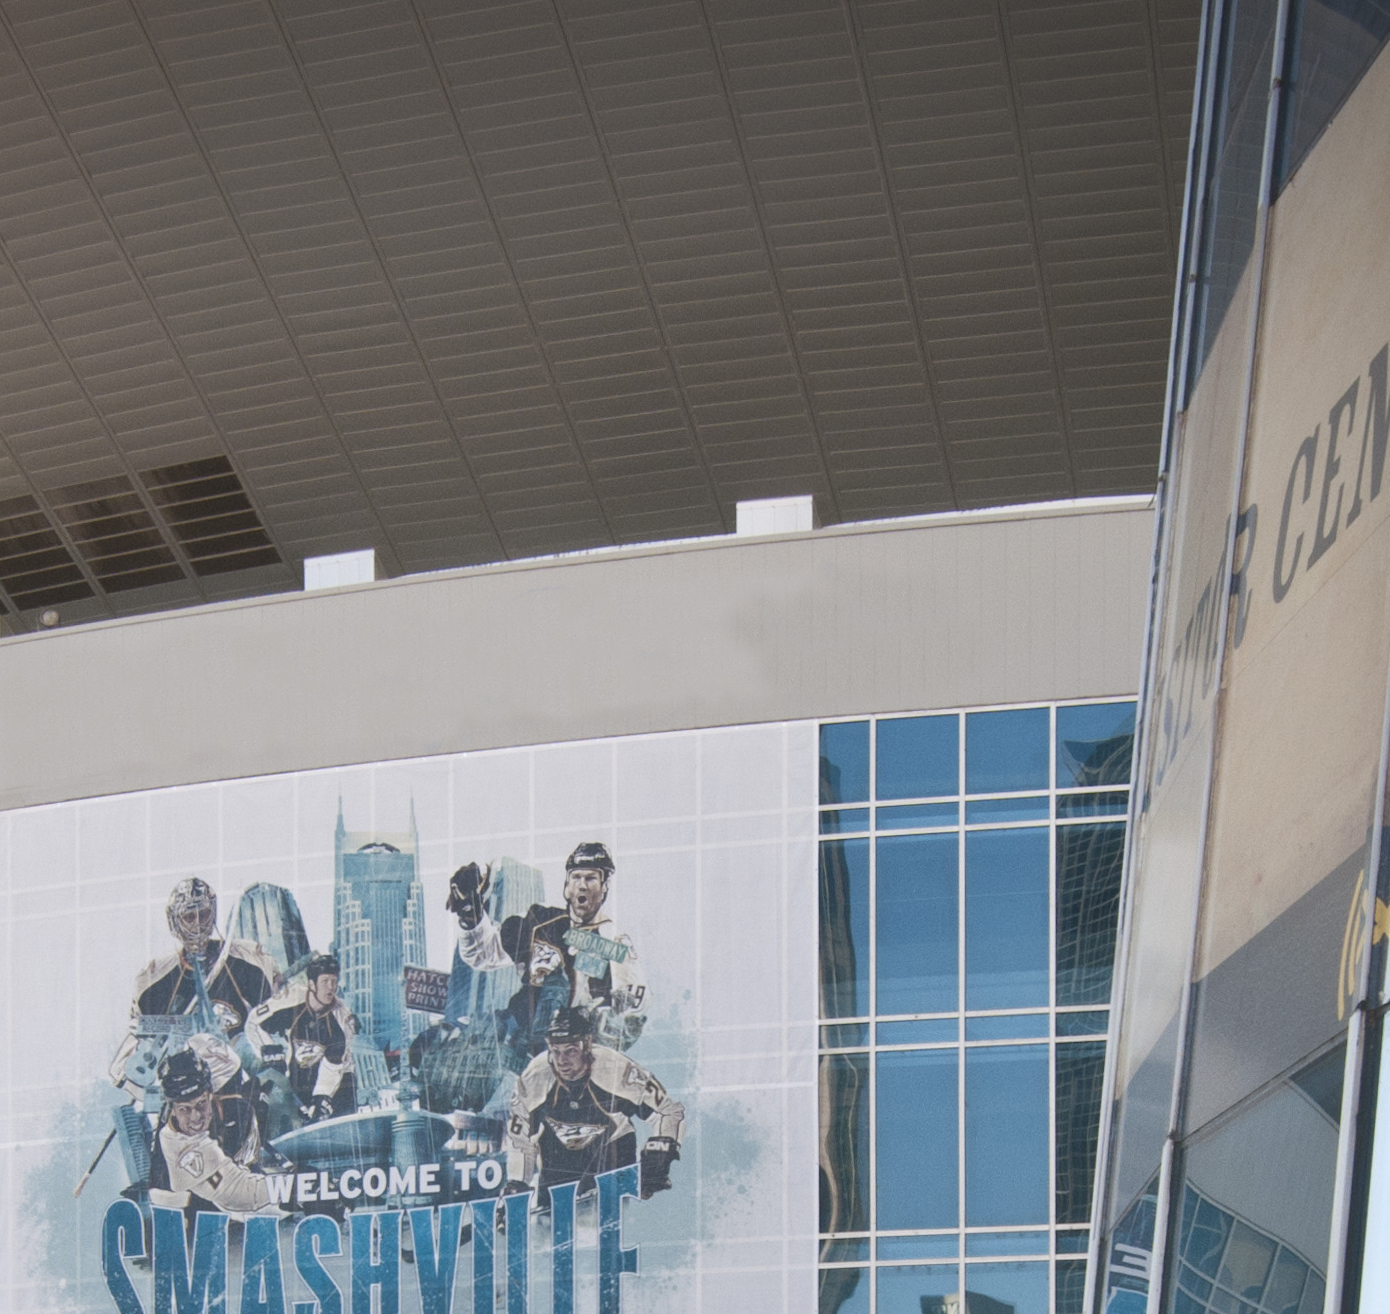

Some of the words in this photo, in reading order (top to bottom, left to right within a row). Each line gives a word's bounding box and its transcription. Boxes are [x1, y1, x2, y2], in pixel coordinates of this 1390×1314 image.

[568, 929, 627, 962] BROADWAY
[407, 969, 447, 986] HATC
[411, 981, 447, 997] SHOW
[265, 1163, 440, 1204] WELCOME
[454, 1159, 503, 1191] TO
